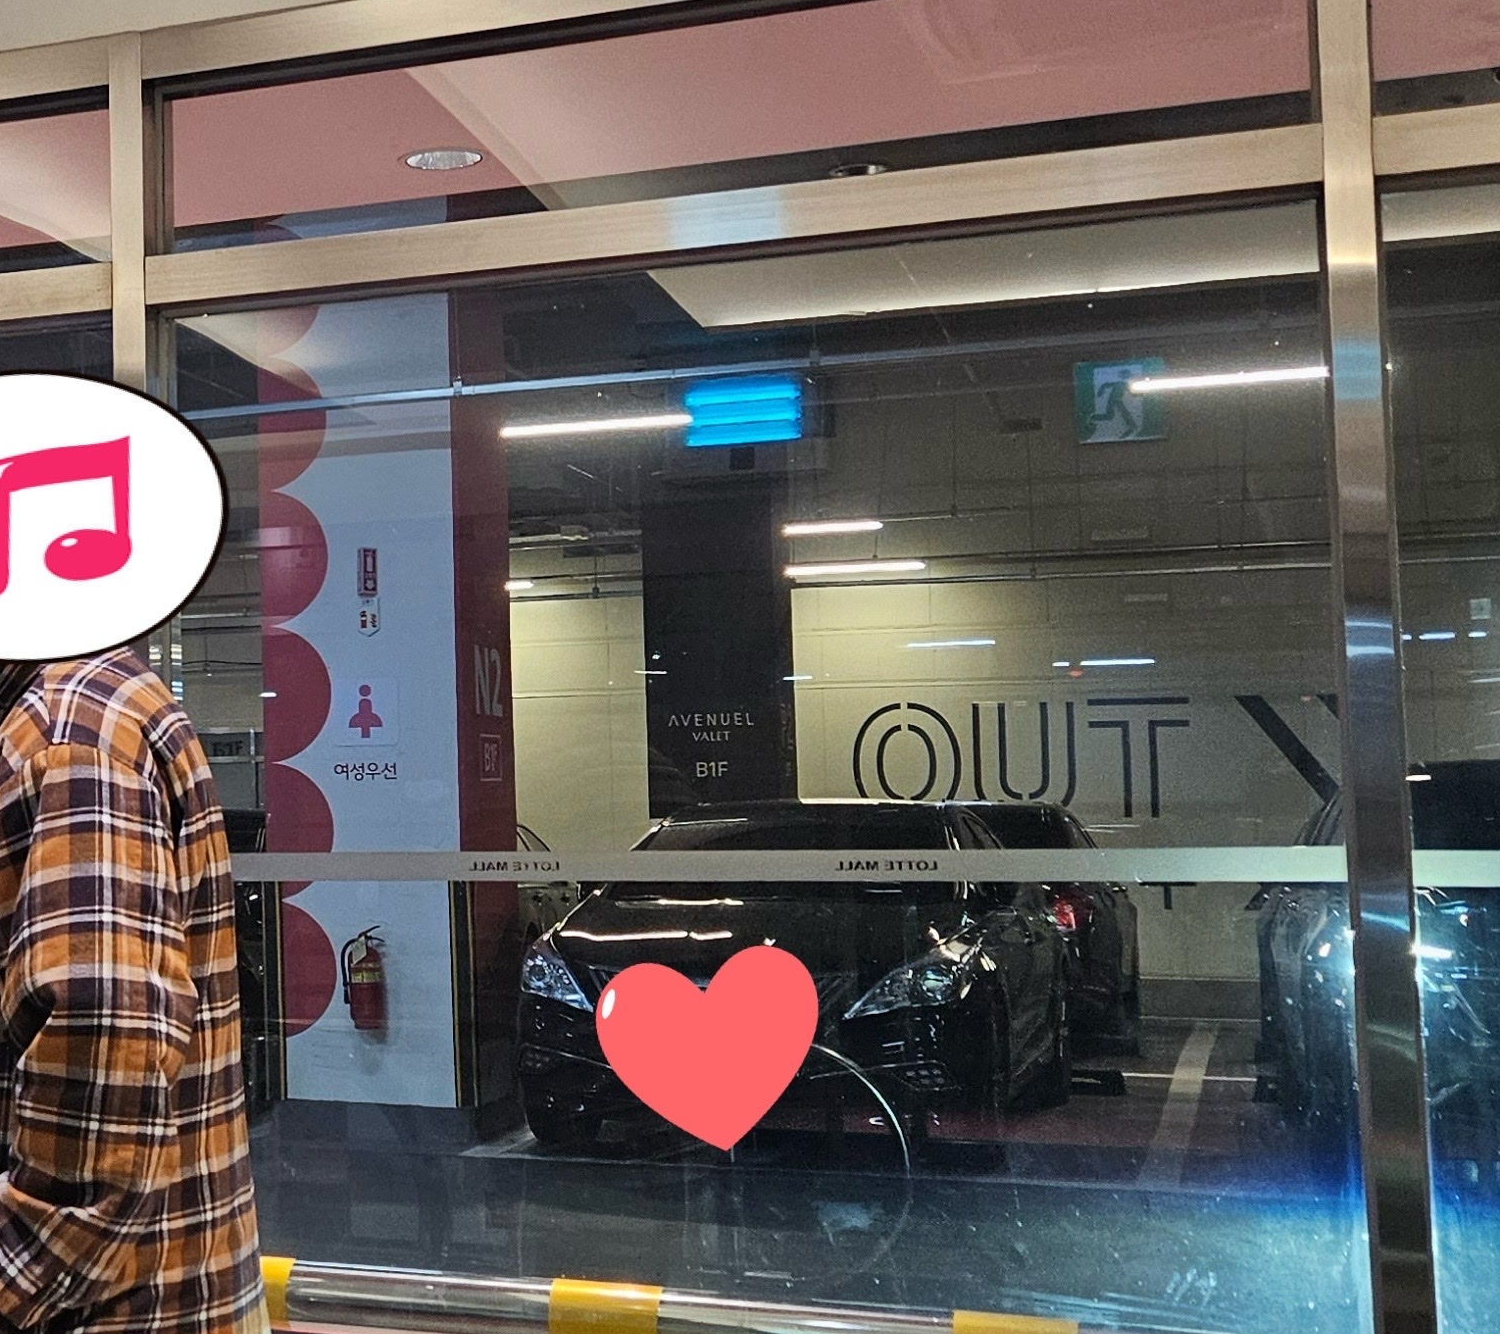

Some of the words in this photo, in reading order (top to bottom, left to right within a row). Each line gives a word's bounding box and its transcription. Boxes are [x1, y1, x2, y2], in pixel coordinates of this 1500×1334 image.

[474, 644, 503, 717] N2
[668, 712, 754, 727] AVENUEL
[692, 730, 731, 742] VALET
[853, 695, 1190, 818] OUT
[334, 762, 398, 781] 여성우선
[696, 761, 729, 777] B1F
